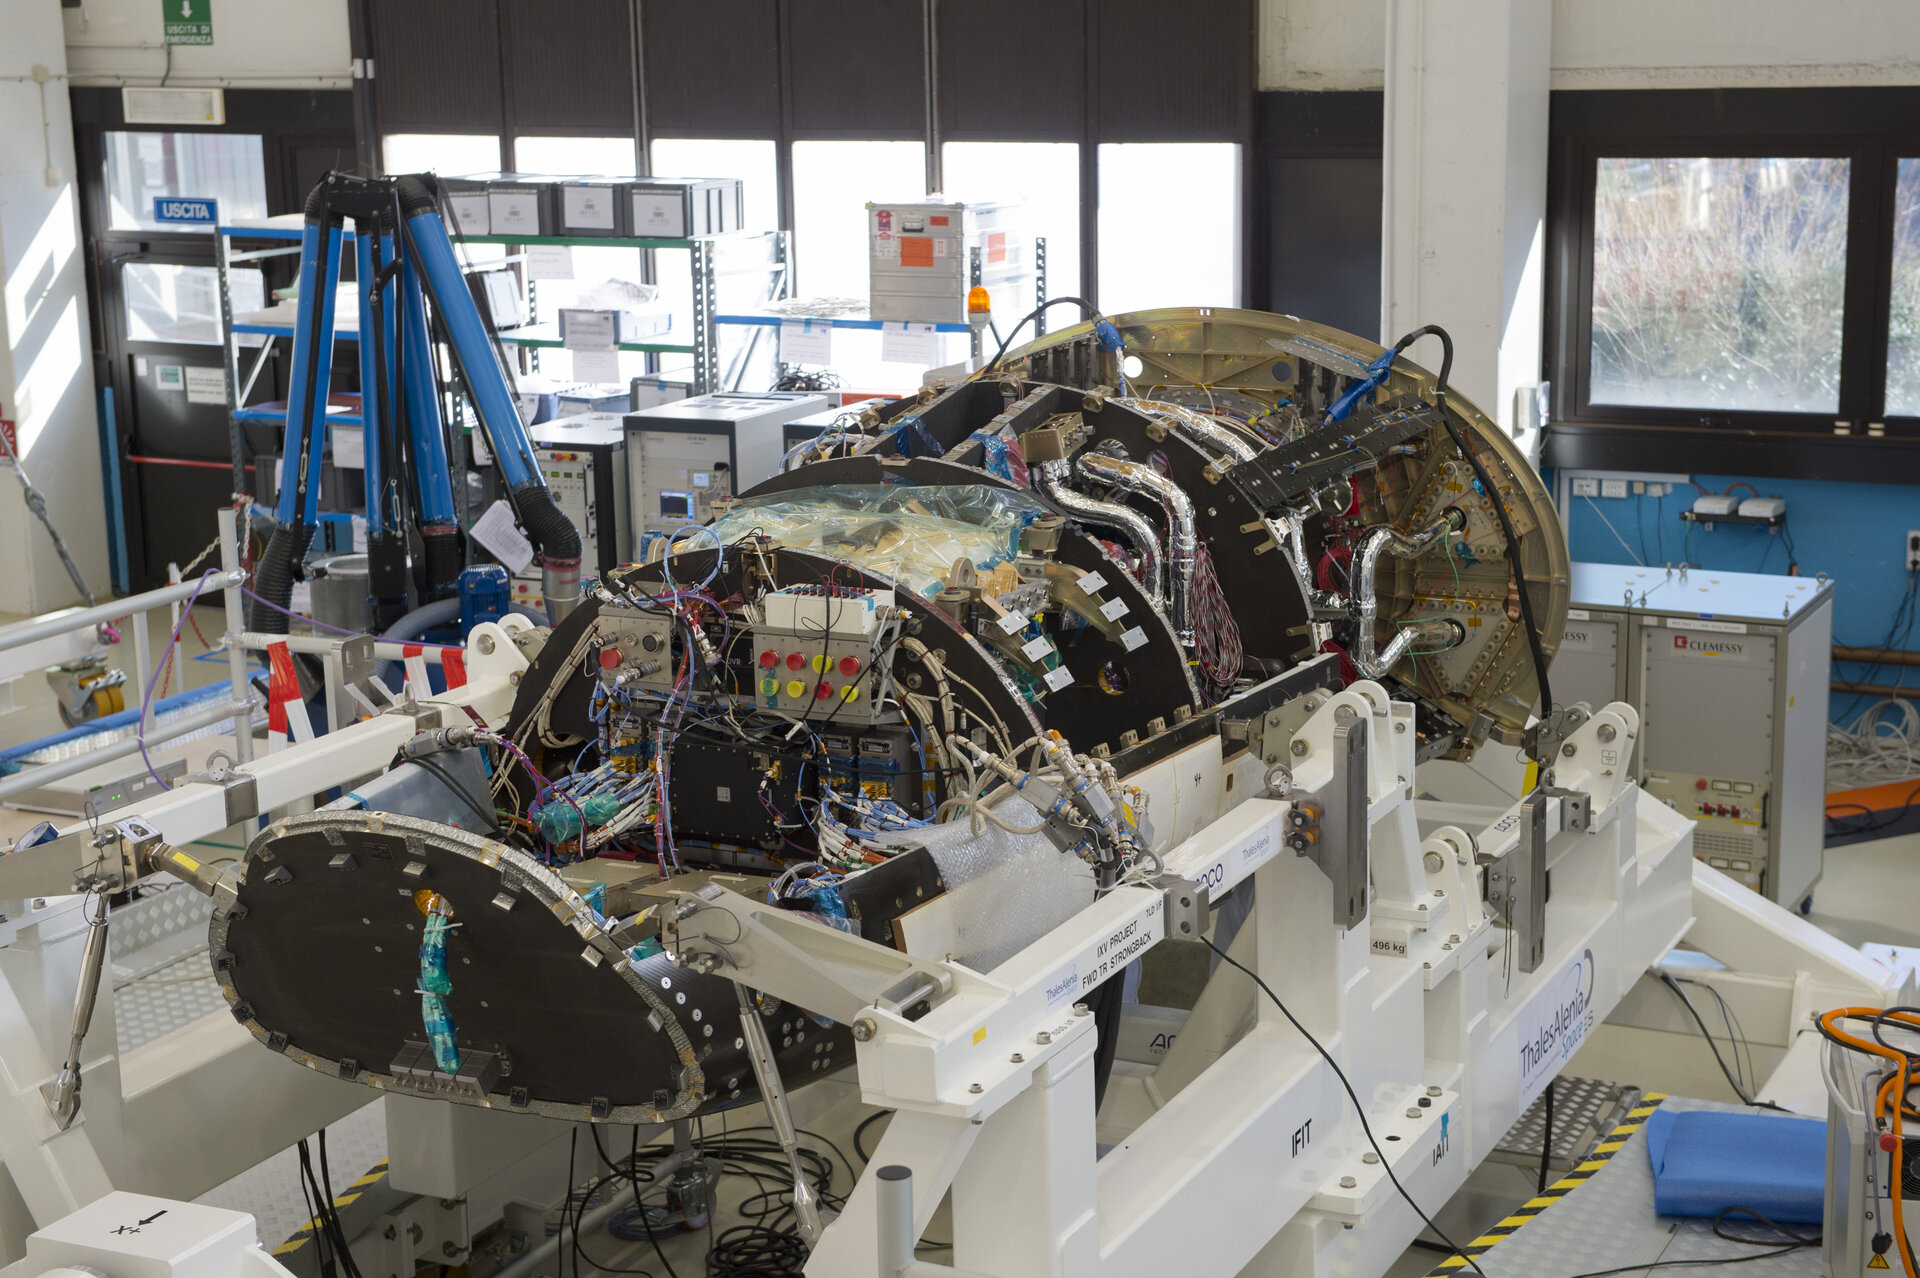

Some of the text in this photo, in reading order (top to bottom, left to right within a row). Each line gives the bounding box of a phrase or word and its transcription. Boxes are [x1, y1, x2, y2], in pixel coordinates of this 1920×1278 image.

[166, 25, 210, 34] USCITA DI
[162, 202, 210, 219] USCITA
[1561, 631, 1588, 642] ESSY
[1689, 640, 1745, 654] CLEMESSY
[1097, 920, 1138, 959] IXV PROJECT
[1372, 941, 1405, 955] 496 kg
[1081, 929, 1153, 990] FWD TR STRONGBACK
[1520, 988, 1584, 1079] ThalesAlenia
[1561, 1020, 1584, 1060] Space
[1291, 1118, 1313, 1158] IFIT
